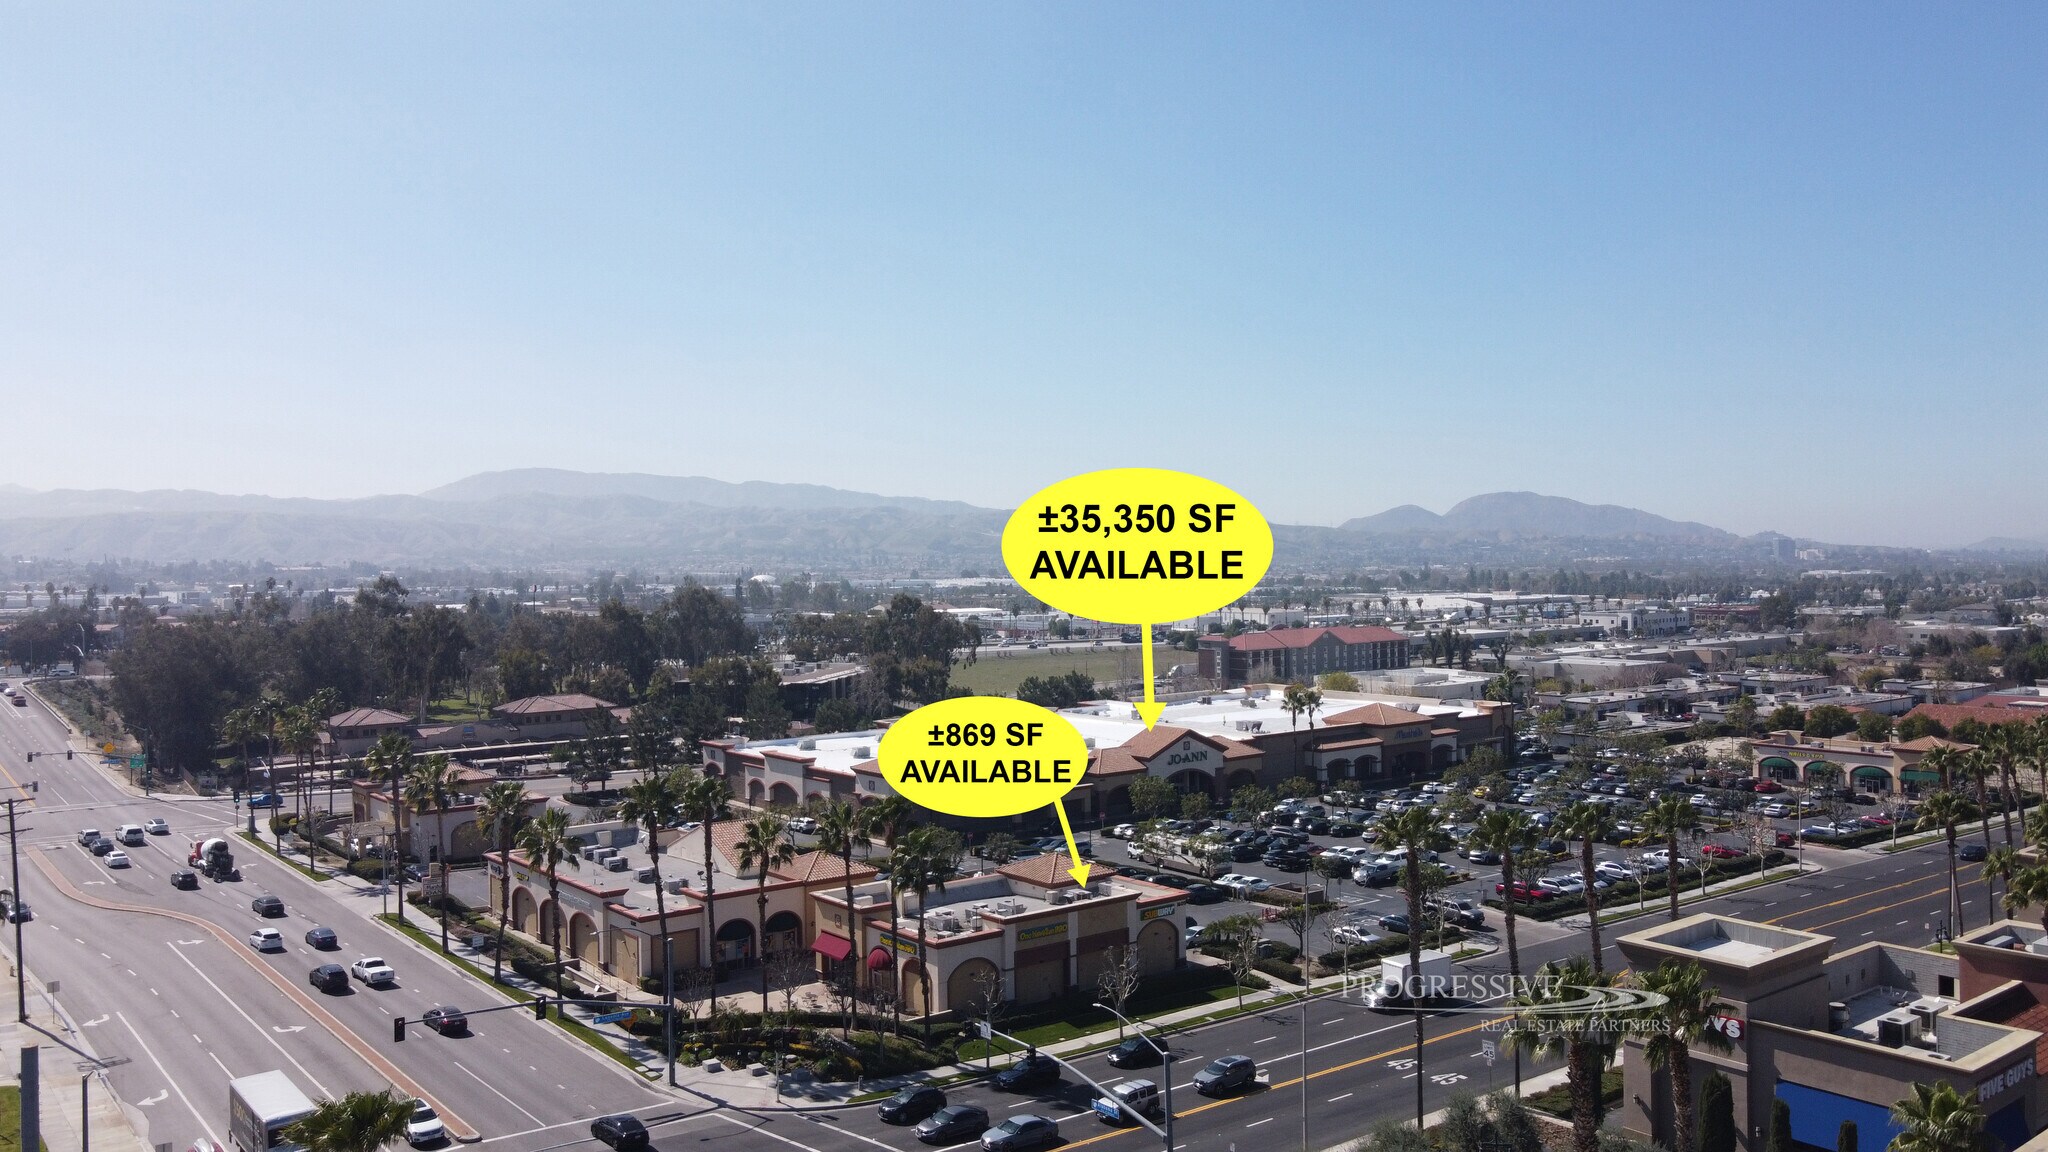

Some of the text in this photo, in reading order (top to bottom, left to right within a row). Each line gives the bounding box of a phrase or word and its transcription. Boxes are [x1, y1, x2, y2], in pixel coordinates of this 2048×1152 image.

[1144, 906, 1174, 919] SUBWAY
[1483, 1050, 1494, 1058] 45
[1430, 1072, 1468, 1085] 45
[1978, 1058, 2034, 1102] FIVE GUYS
